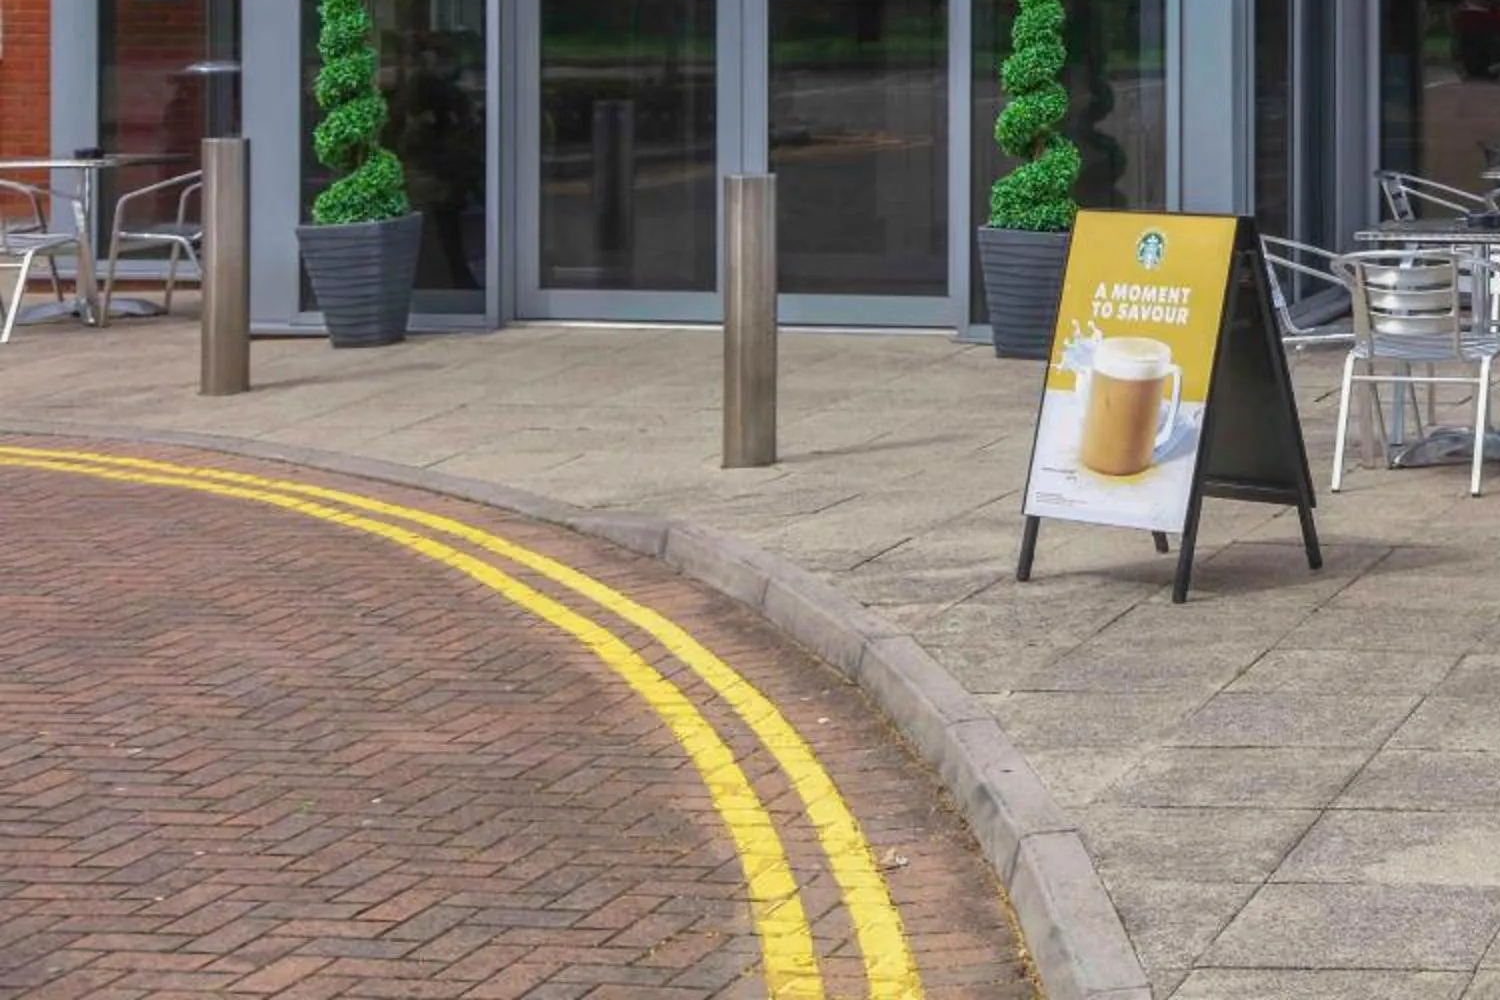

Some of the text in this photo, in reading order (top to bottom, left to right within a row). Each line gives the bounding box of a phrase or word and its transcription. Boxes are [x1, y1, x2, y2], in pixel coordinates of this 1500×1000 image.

[1094, 282, 1192, 304] A MOMENT
[1091, 300, 1190, 325] TO SAVOUR
